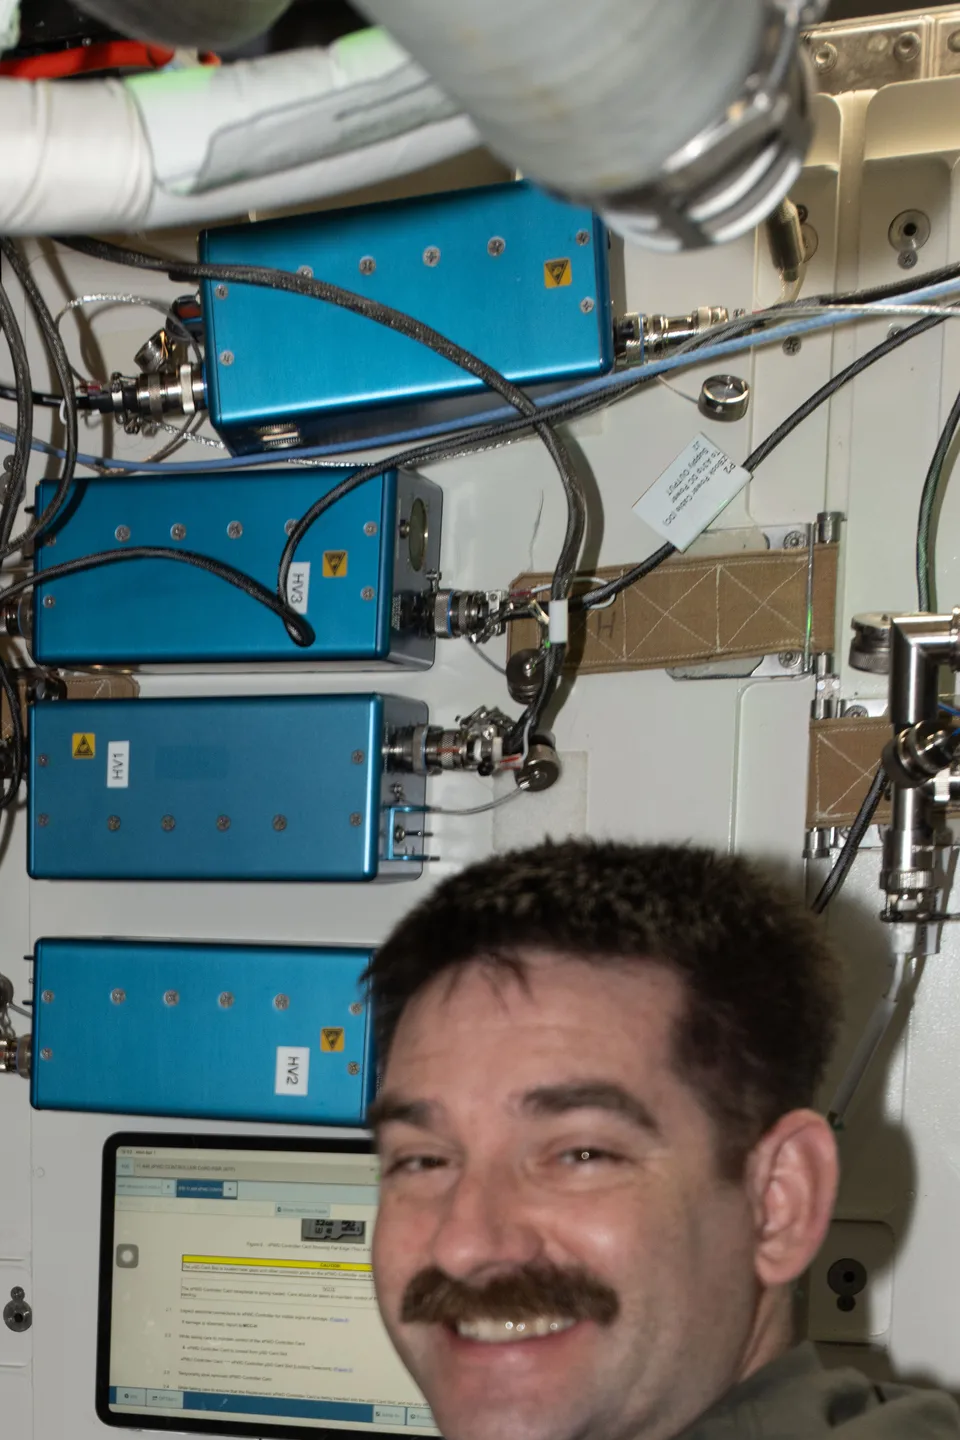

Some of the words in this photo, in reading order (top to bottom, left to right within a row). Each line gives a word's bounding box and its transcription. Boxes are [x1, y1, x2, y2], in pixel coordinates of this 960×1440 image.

[686, 445, 709, 470] Supply
[709, 447, 721, 460] To
[707, 453, 729, 477] ZBook
[722, 460, 736, 475] P2
[664, 467, 690, 497] OUTPUT
[686, 472, 698, 485] DC
[690, 474, 710, 496] Power
[669, 482, 689, 504] Power
[674, 493, 693, 514] Cable
[661, 509, 678, 528] (DC)
[290, 572, 303, 604] HV3
[111, 752, 124, 780] HV1
[285, 1055, 299, 1085] HV2
